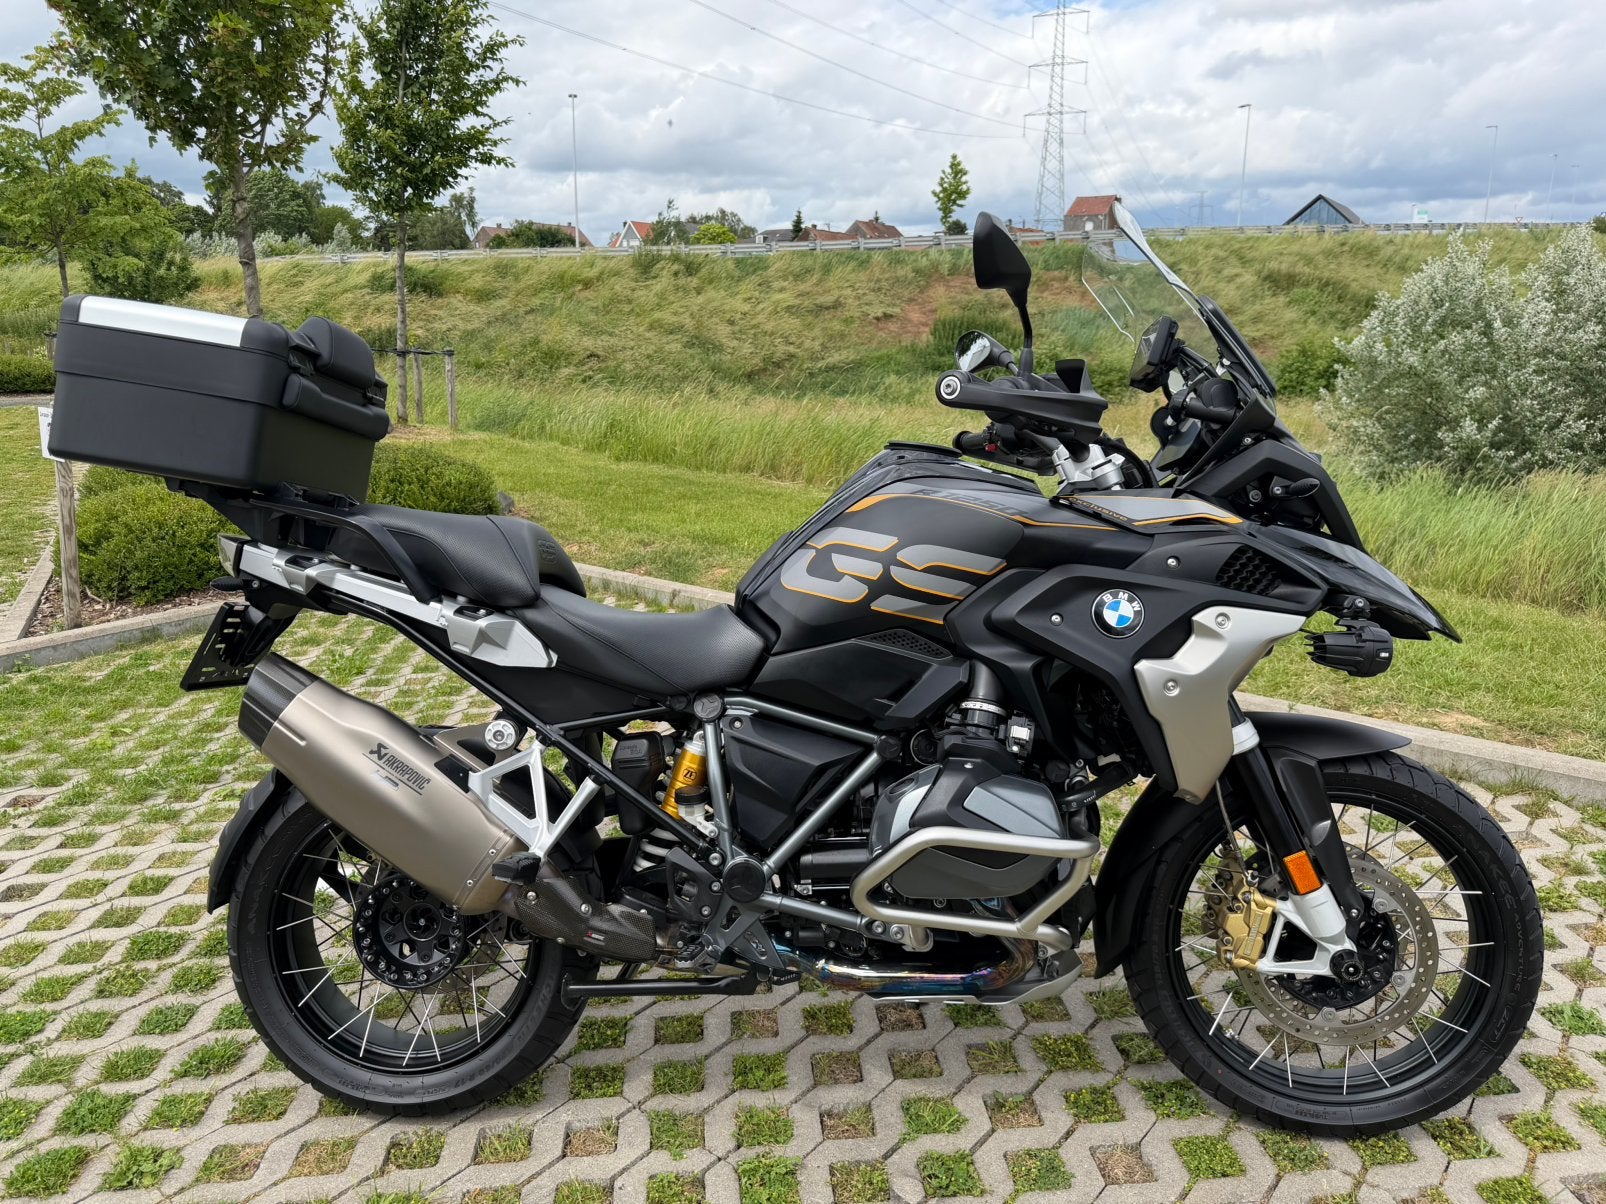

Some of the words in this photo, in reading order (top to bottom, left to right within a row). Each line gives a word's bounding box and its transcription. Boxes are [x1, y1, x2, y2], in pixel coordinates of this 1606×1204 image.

[1068, 497, 1128, 521] exclusive
[780, 526, 1008, 625] GS
[1102, 591, 1142, 611] BMW
[382, 754, 432, 791] AKRAPOVIČ
[683, 769, 696, 779] ZF
